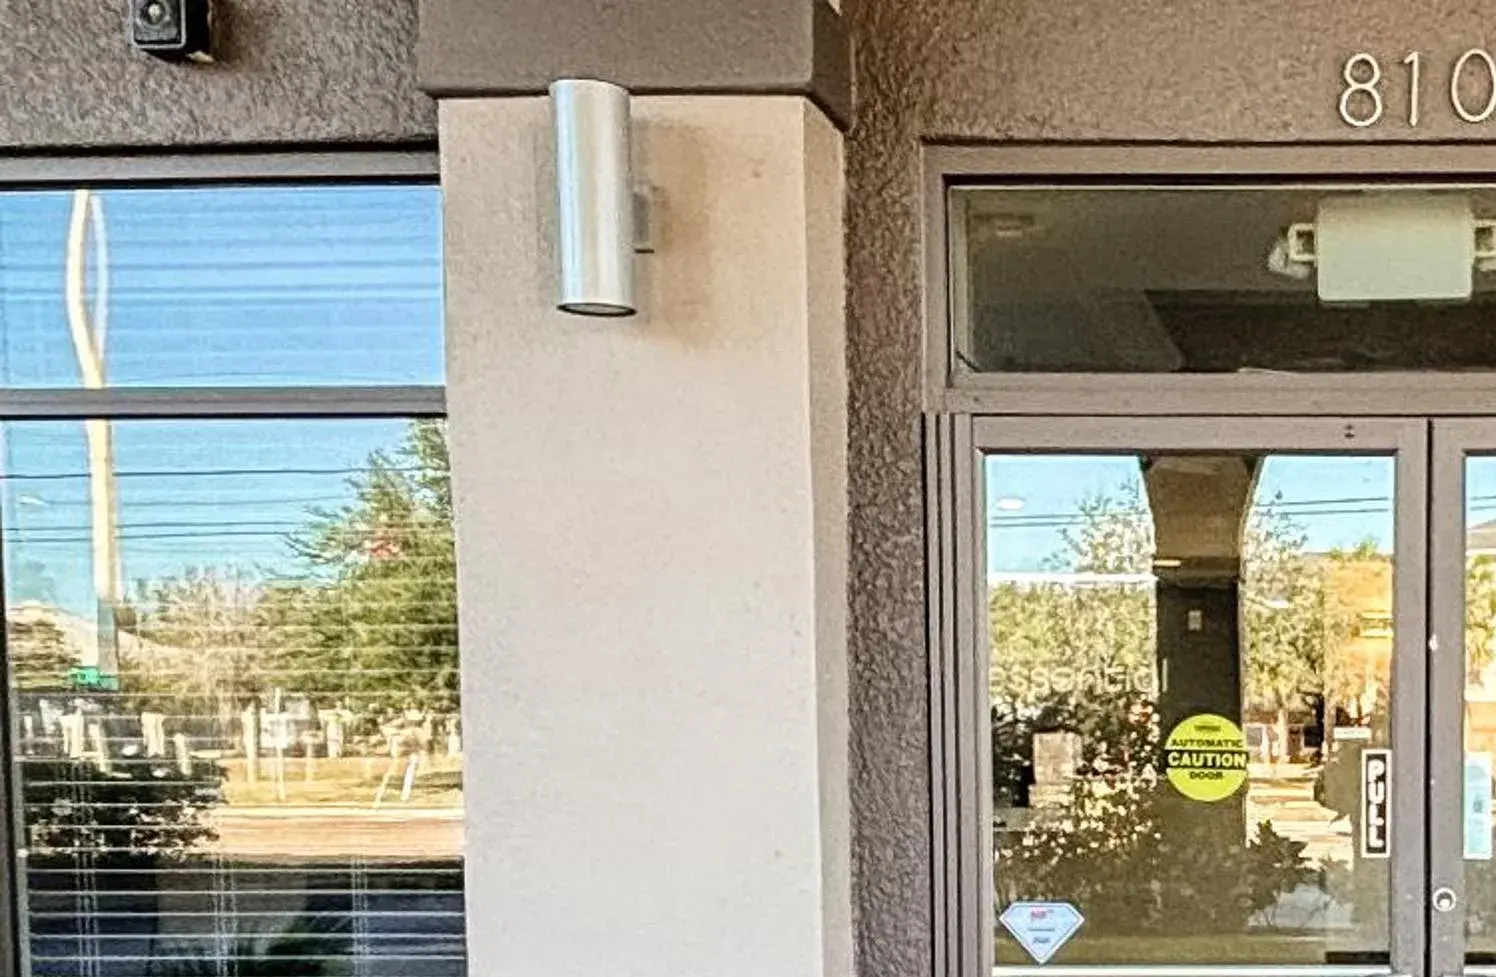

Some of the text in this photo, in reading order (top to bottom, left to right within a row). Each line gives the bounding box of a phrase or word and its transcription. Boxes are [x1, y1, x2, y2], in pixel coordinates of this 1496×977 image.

[1171, 738, 1243, 749] AUTOMATIC
[1167, 751, 1247, 768] CAUTION
[1189, 771, 1224, 781] DOOR
[1367, 758, 1386, 848] PULL
